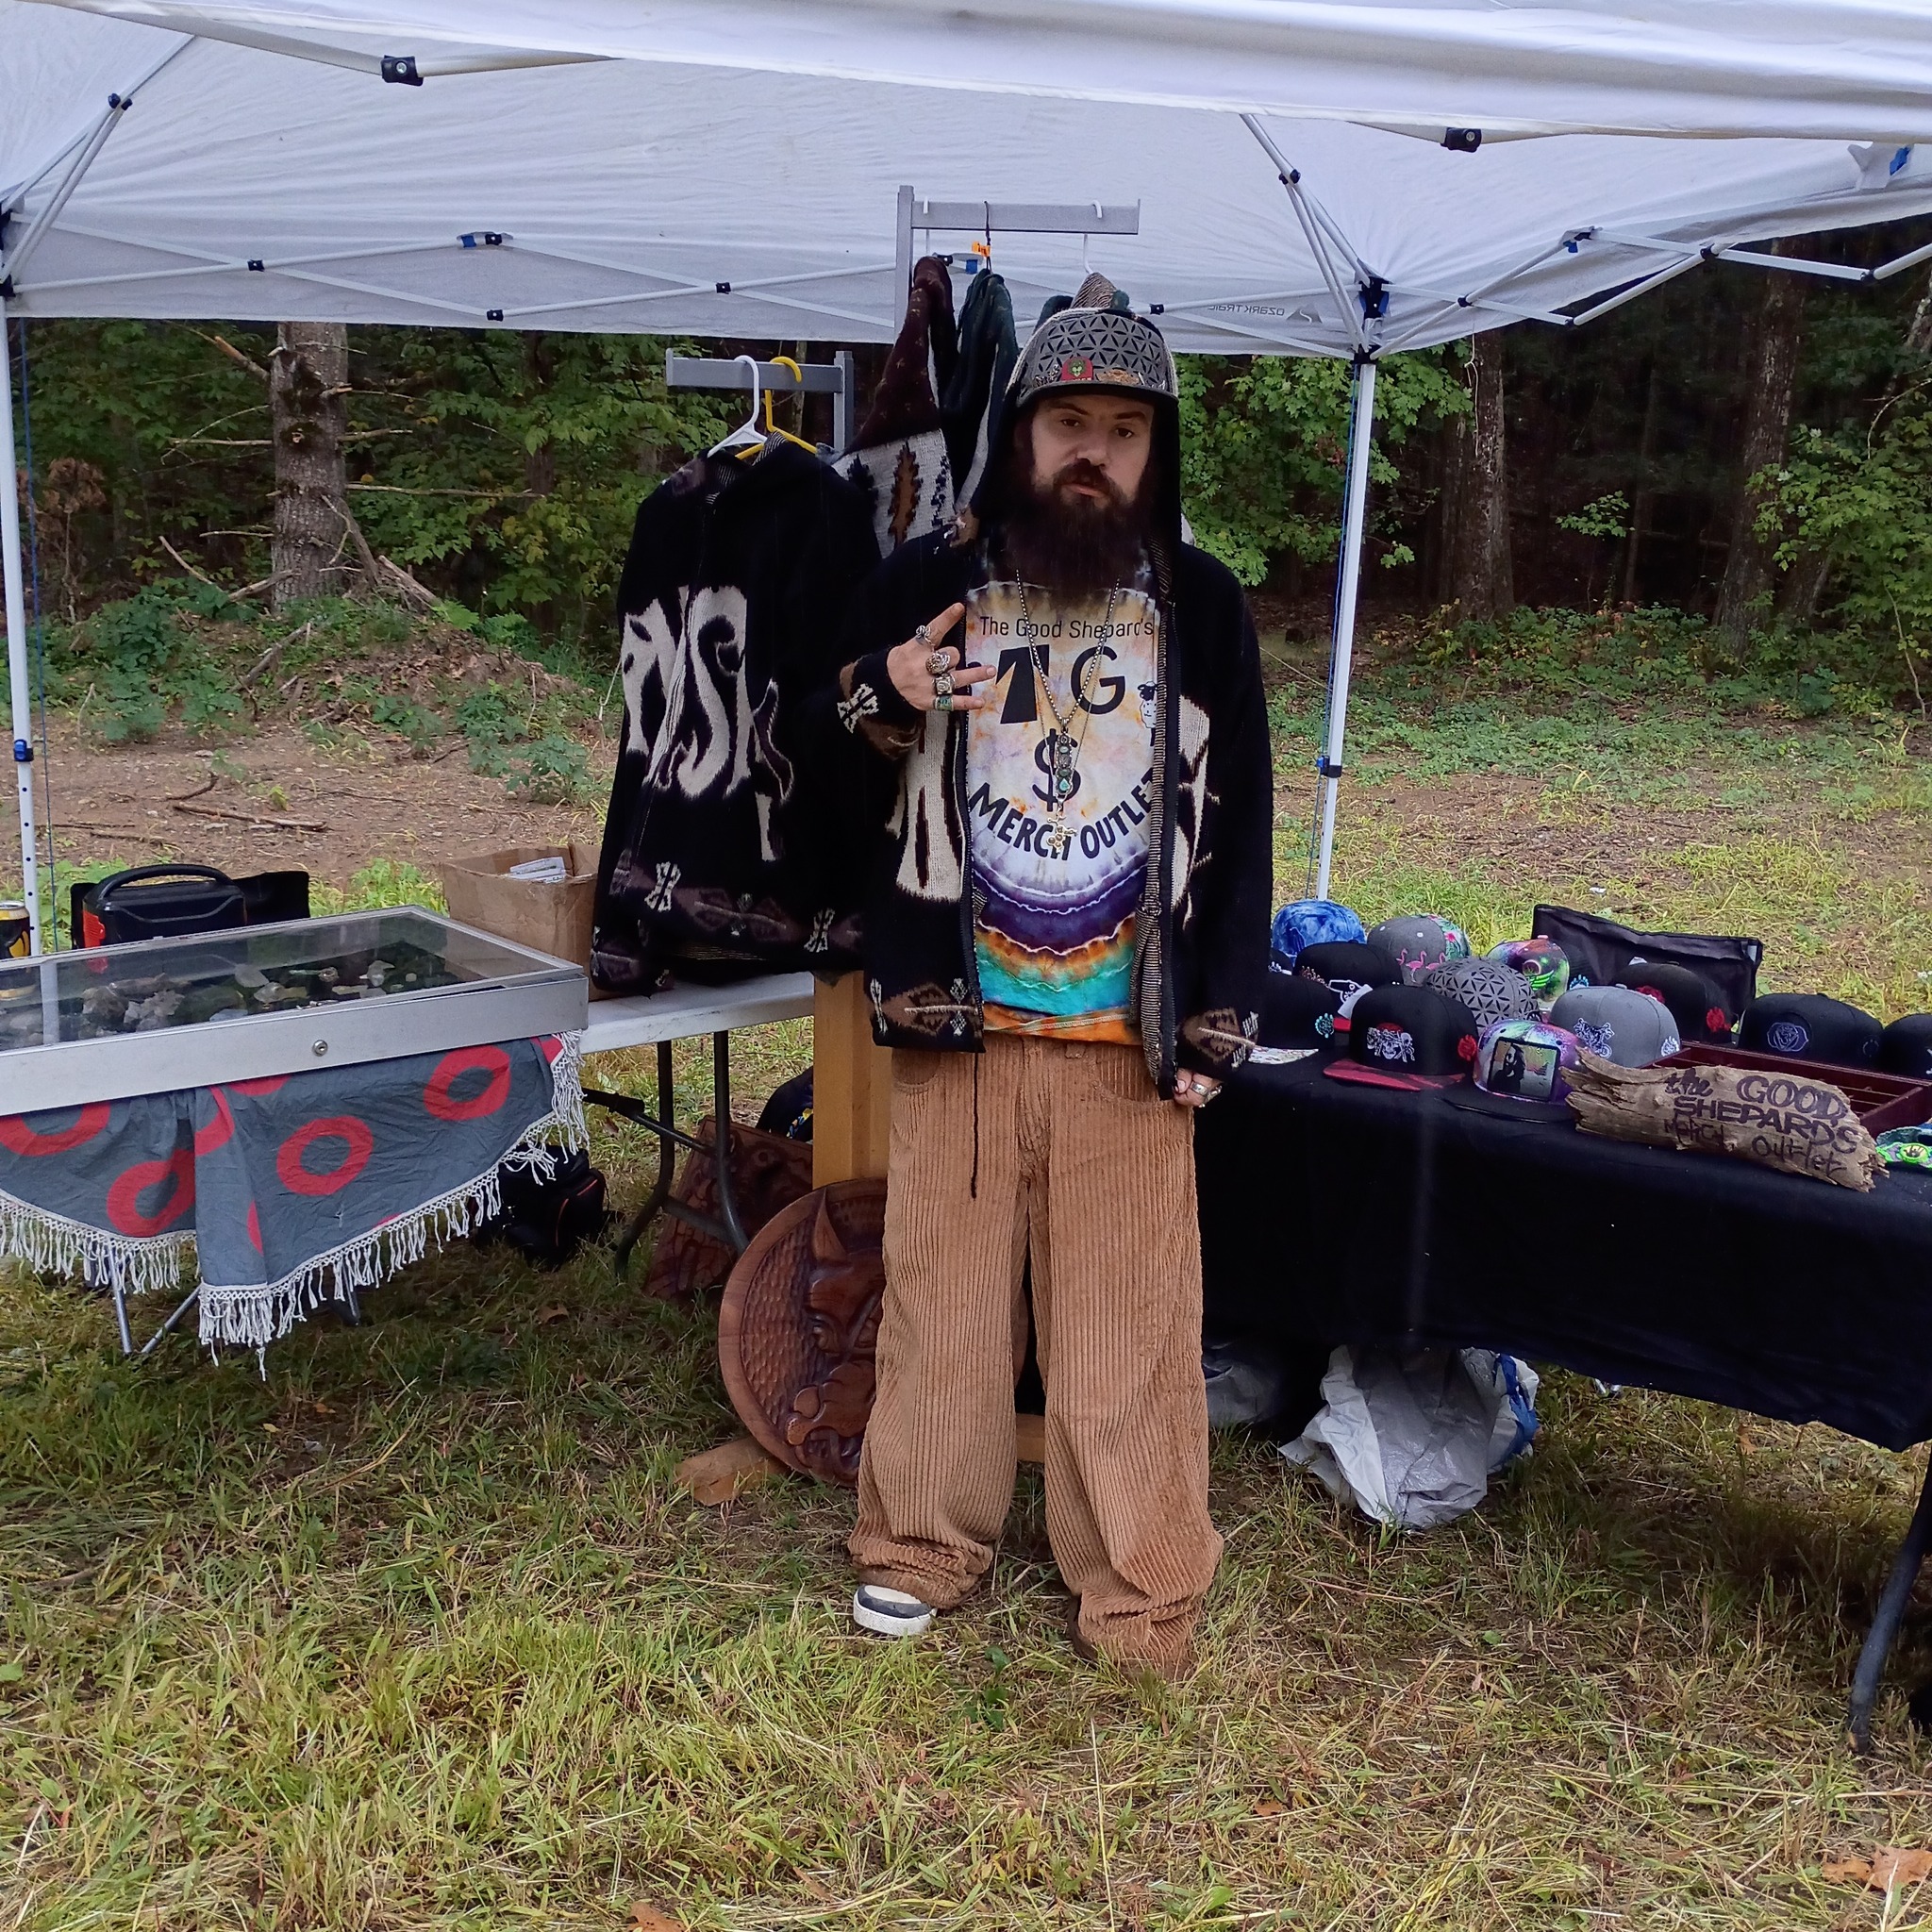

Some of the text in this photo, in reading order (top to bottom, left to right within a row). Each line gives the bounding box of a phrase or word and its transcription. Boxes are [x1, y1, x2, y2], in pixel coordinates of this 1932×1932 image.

[980, 616, 1154, 642] The Good Shepard's
[1664, 1067, 1849, 1121] the GOOD
[1674, 1096, 1859, 1155] SHEPARD'S
